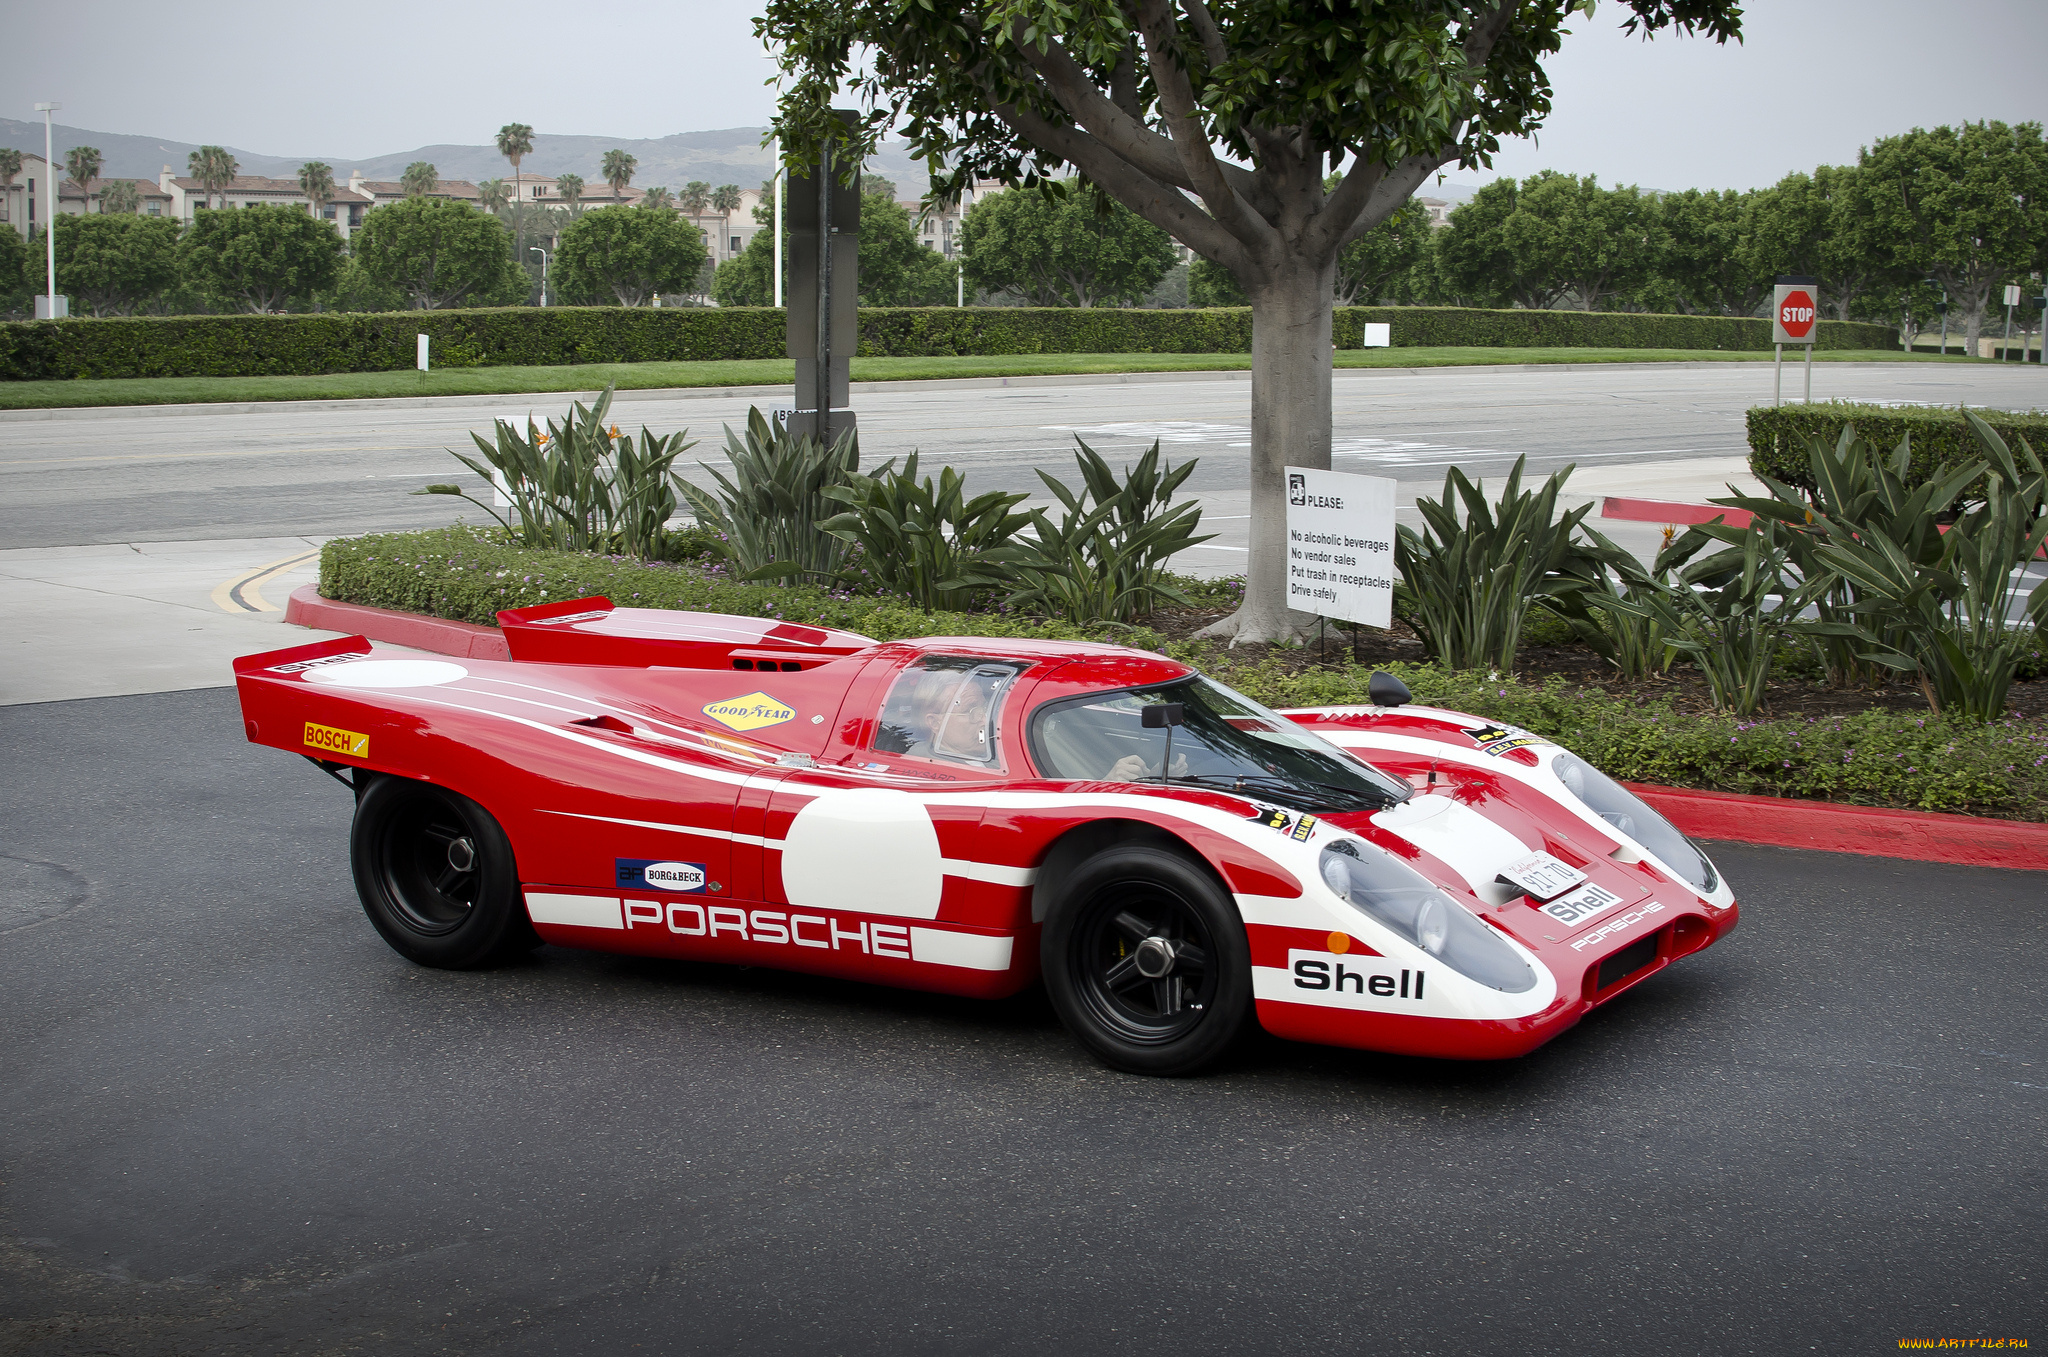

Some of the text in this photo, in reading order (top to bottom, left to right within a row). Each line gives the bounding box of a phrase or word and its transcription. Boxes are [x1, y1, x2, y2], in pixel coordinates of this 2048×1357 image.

[1782, 307, 1813, 322] STOP
[1308, 495, 1344, 510] PLEASE:
[1291, 529, 1389, 553] No alcoholic beverages
[1291, 547, 1356, 567] No vendor sales
[1291, 565, 1391, 590] Put trash in receptacles
[1291, 582, 1337, 603] Drive safely
[273, 653, 364, 672] Shell
[305, 726, 351, 751] BOSCH
[648, 869, 702, 883] BORG&BECK
[1546, 886, 1616, 922] Shell
[623, 898, 910, 960] PORSCHE
[1569, 900, 1666, 952] PORSCHE
[1294, 959, 1425, 1000] Shell
